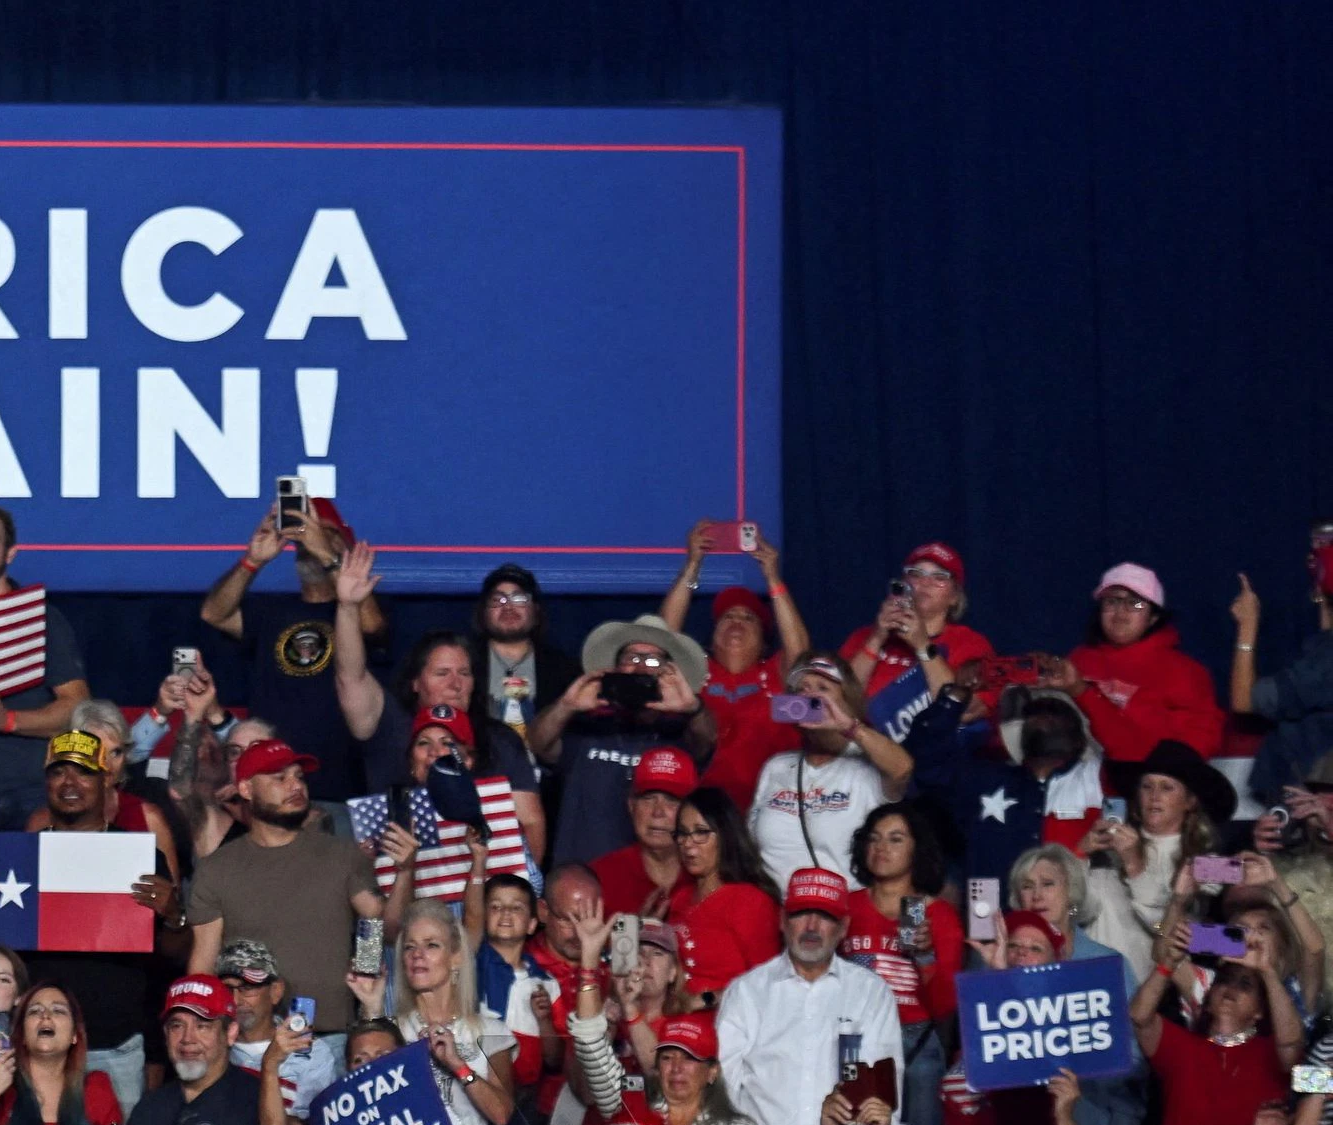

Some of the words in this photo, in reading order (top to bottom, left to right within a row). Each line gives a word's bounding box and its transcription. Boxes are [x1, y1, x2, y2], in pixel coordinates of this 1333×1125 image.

[170, 982, 213, 998] TRUMP
[977, 989, 1112, 1032] LOWER
[982, 1022, 1114, 1063] PRICES
[357, 1064, 410, 1104] TAX
